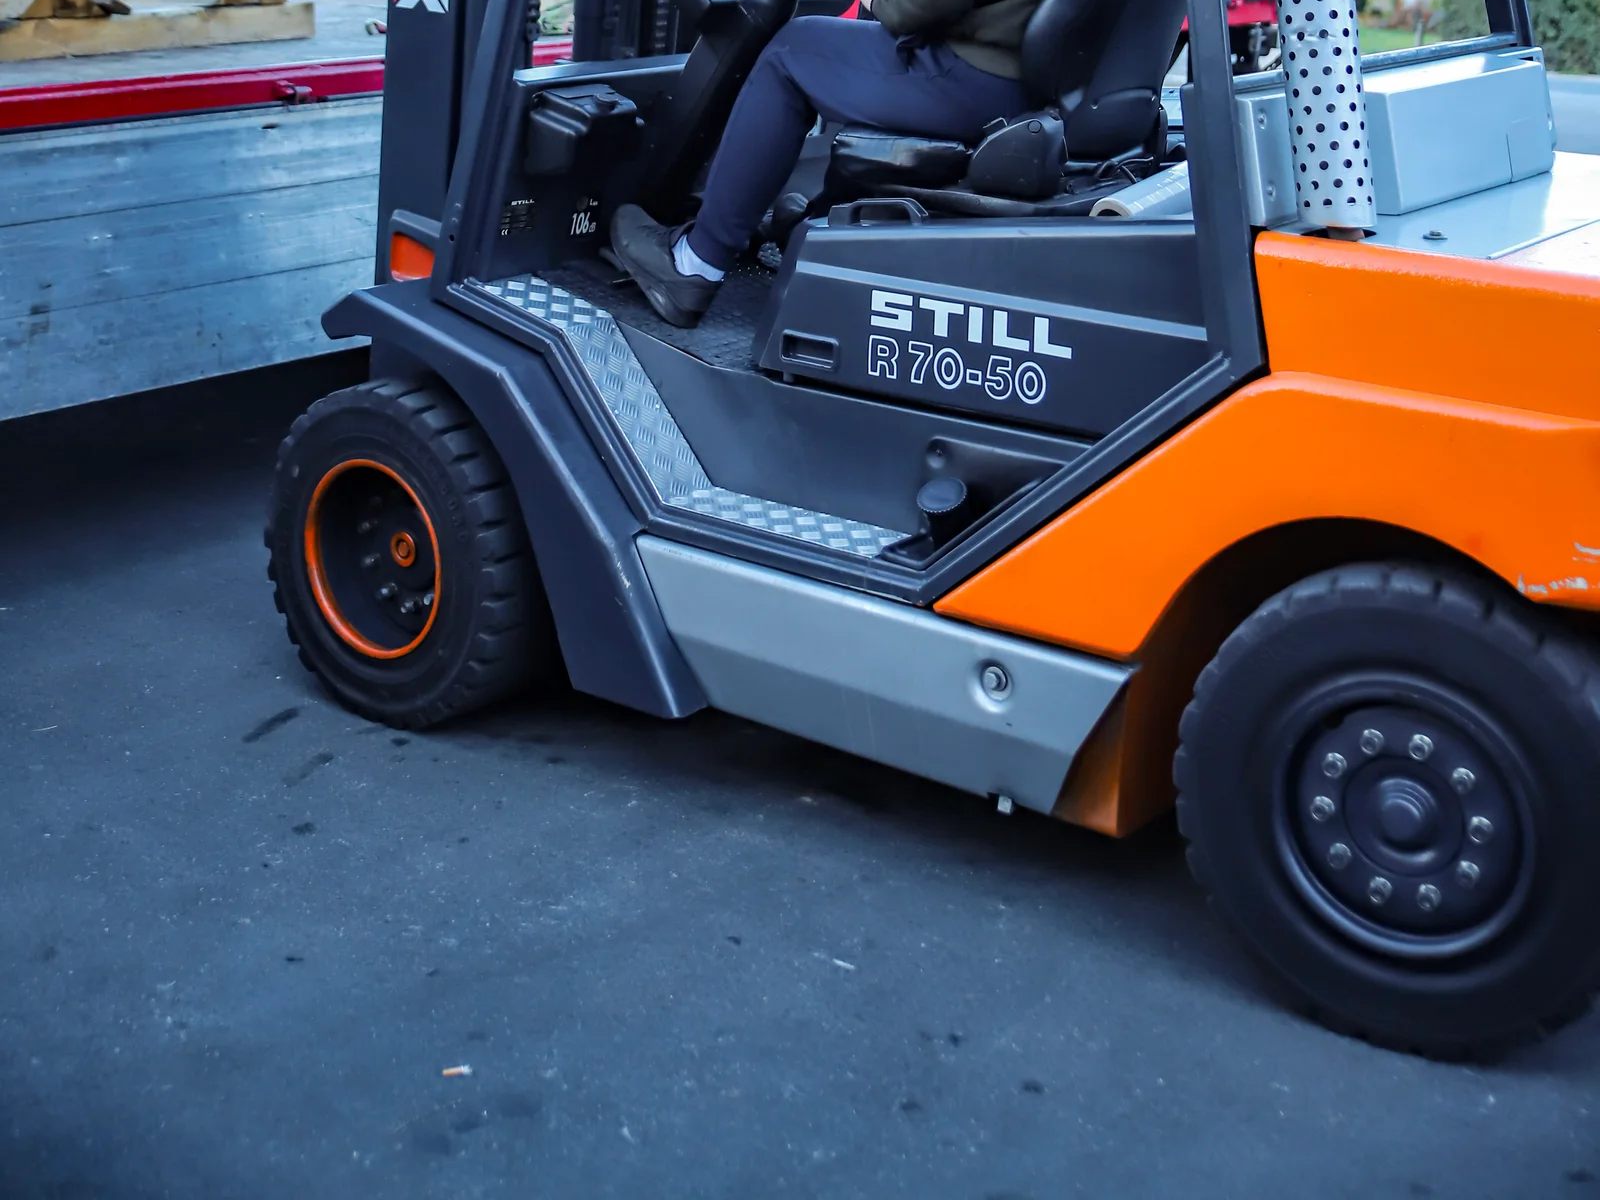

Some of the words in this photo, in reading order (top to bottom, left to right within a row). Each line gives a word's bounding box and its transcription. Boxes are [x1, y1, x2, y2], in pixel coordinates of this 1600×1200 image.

[570, 211, 591, 236] 106
[870, 289, 1072, 359] STILL
[868, 334, 899, 379] R
[907, 340, 1047, 404] 70-50
